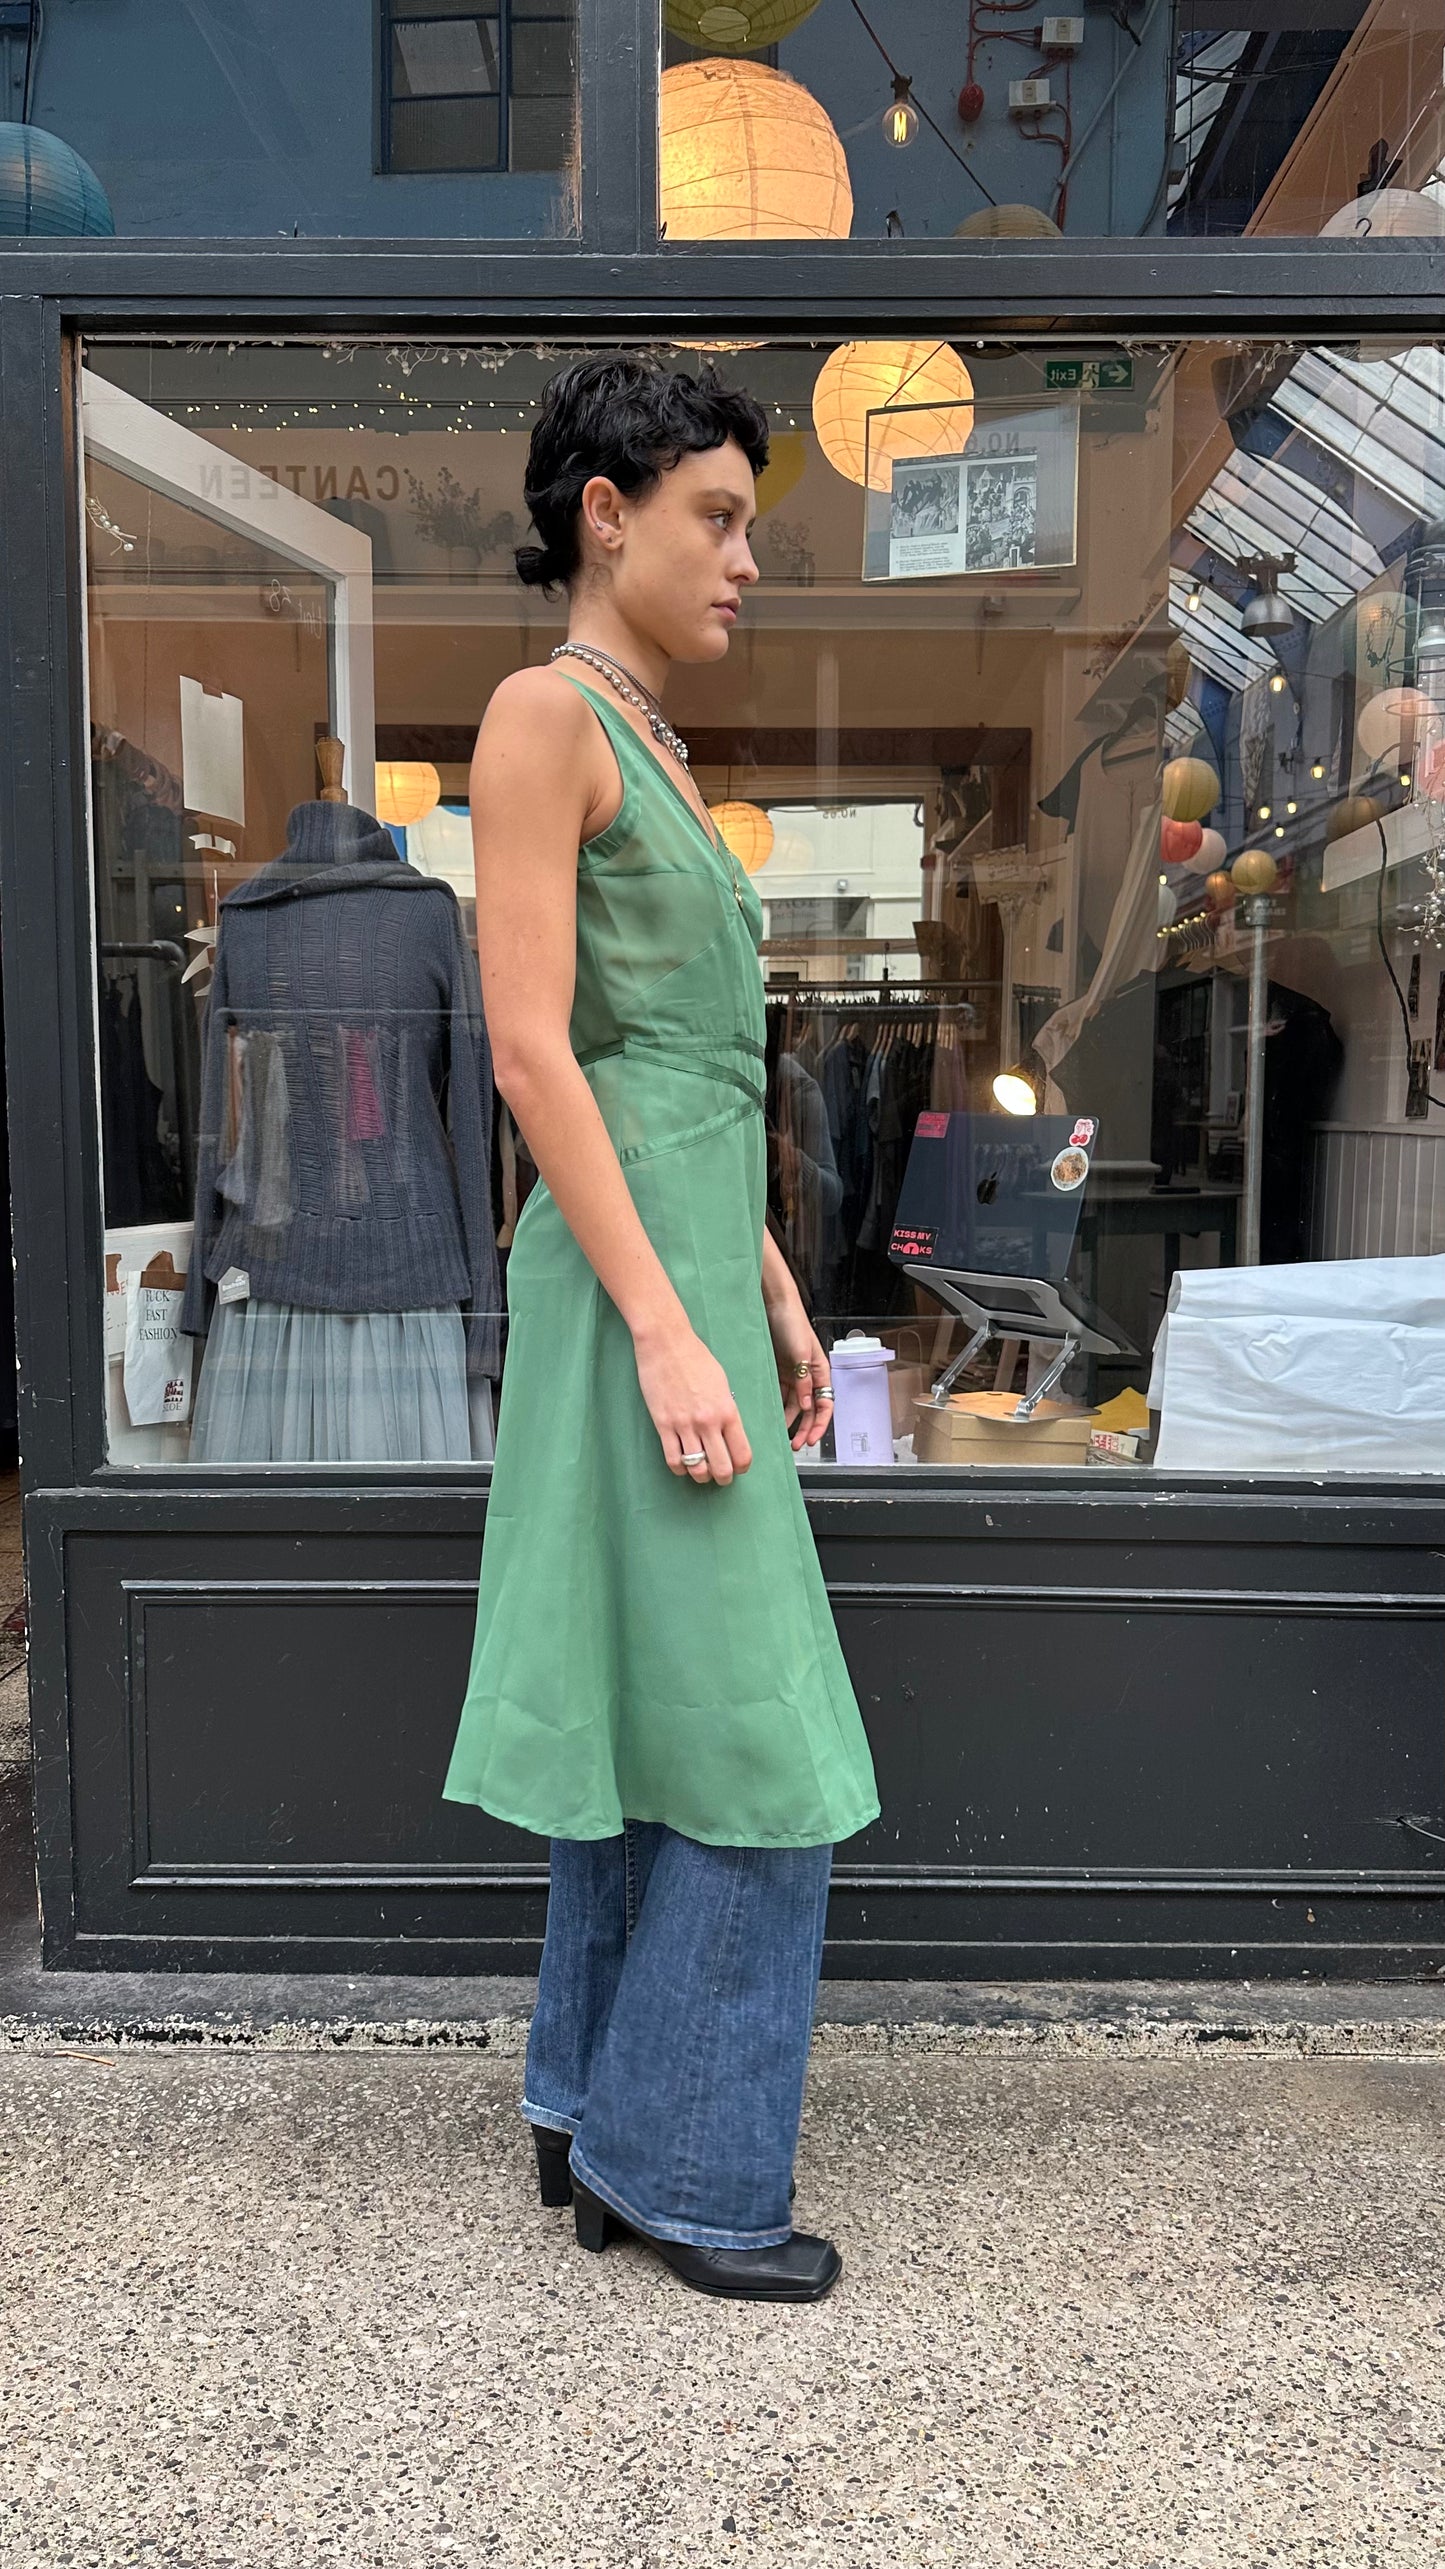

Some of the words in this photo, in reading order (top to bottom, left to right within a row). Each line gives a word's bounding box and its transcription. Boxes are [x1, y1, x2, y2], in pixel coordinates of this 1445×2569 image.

[750, 732, 912, 762] VINAGE
[893, 1229, 917, 1240] KISS
[917, 1231, 932, 1241] MY
[145, 1308, 168, 1321] FAST
[139, 1327, 178, 1341] FASHION
